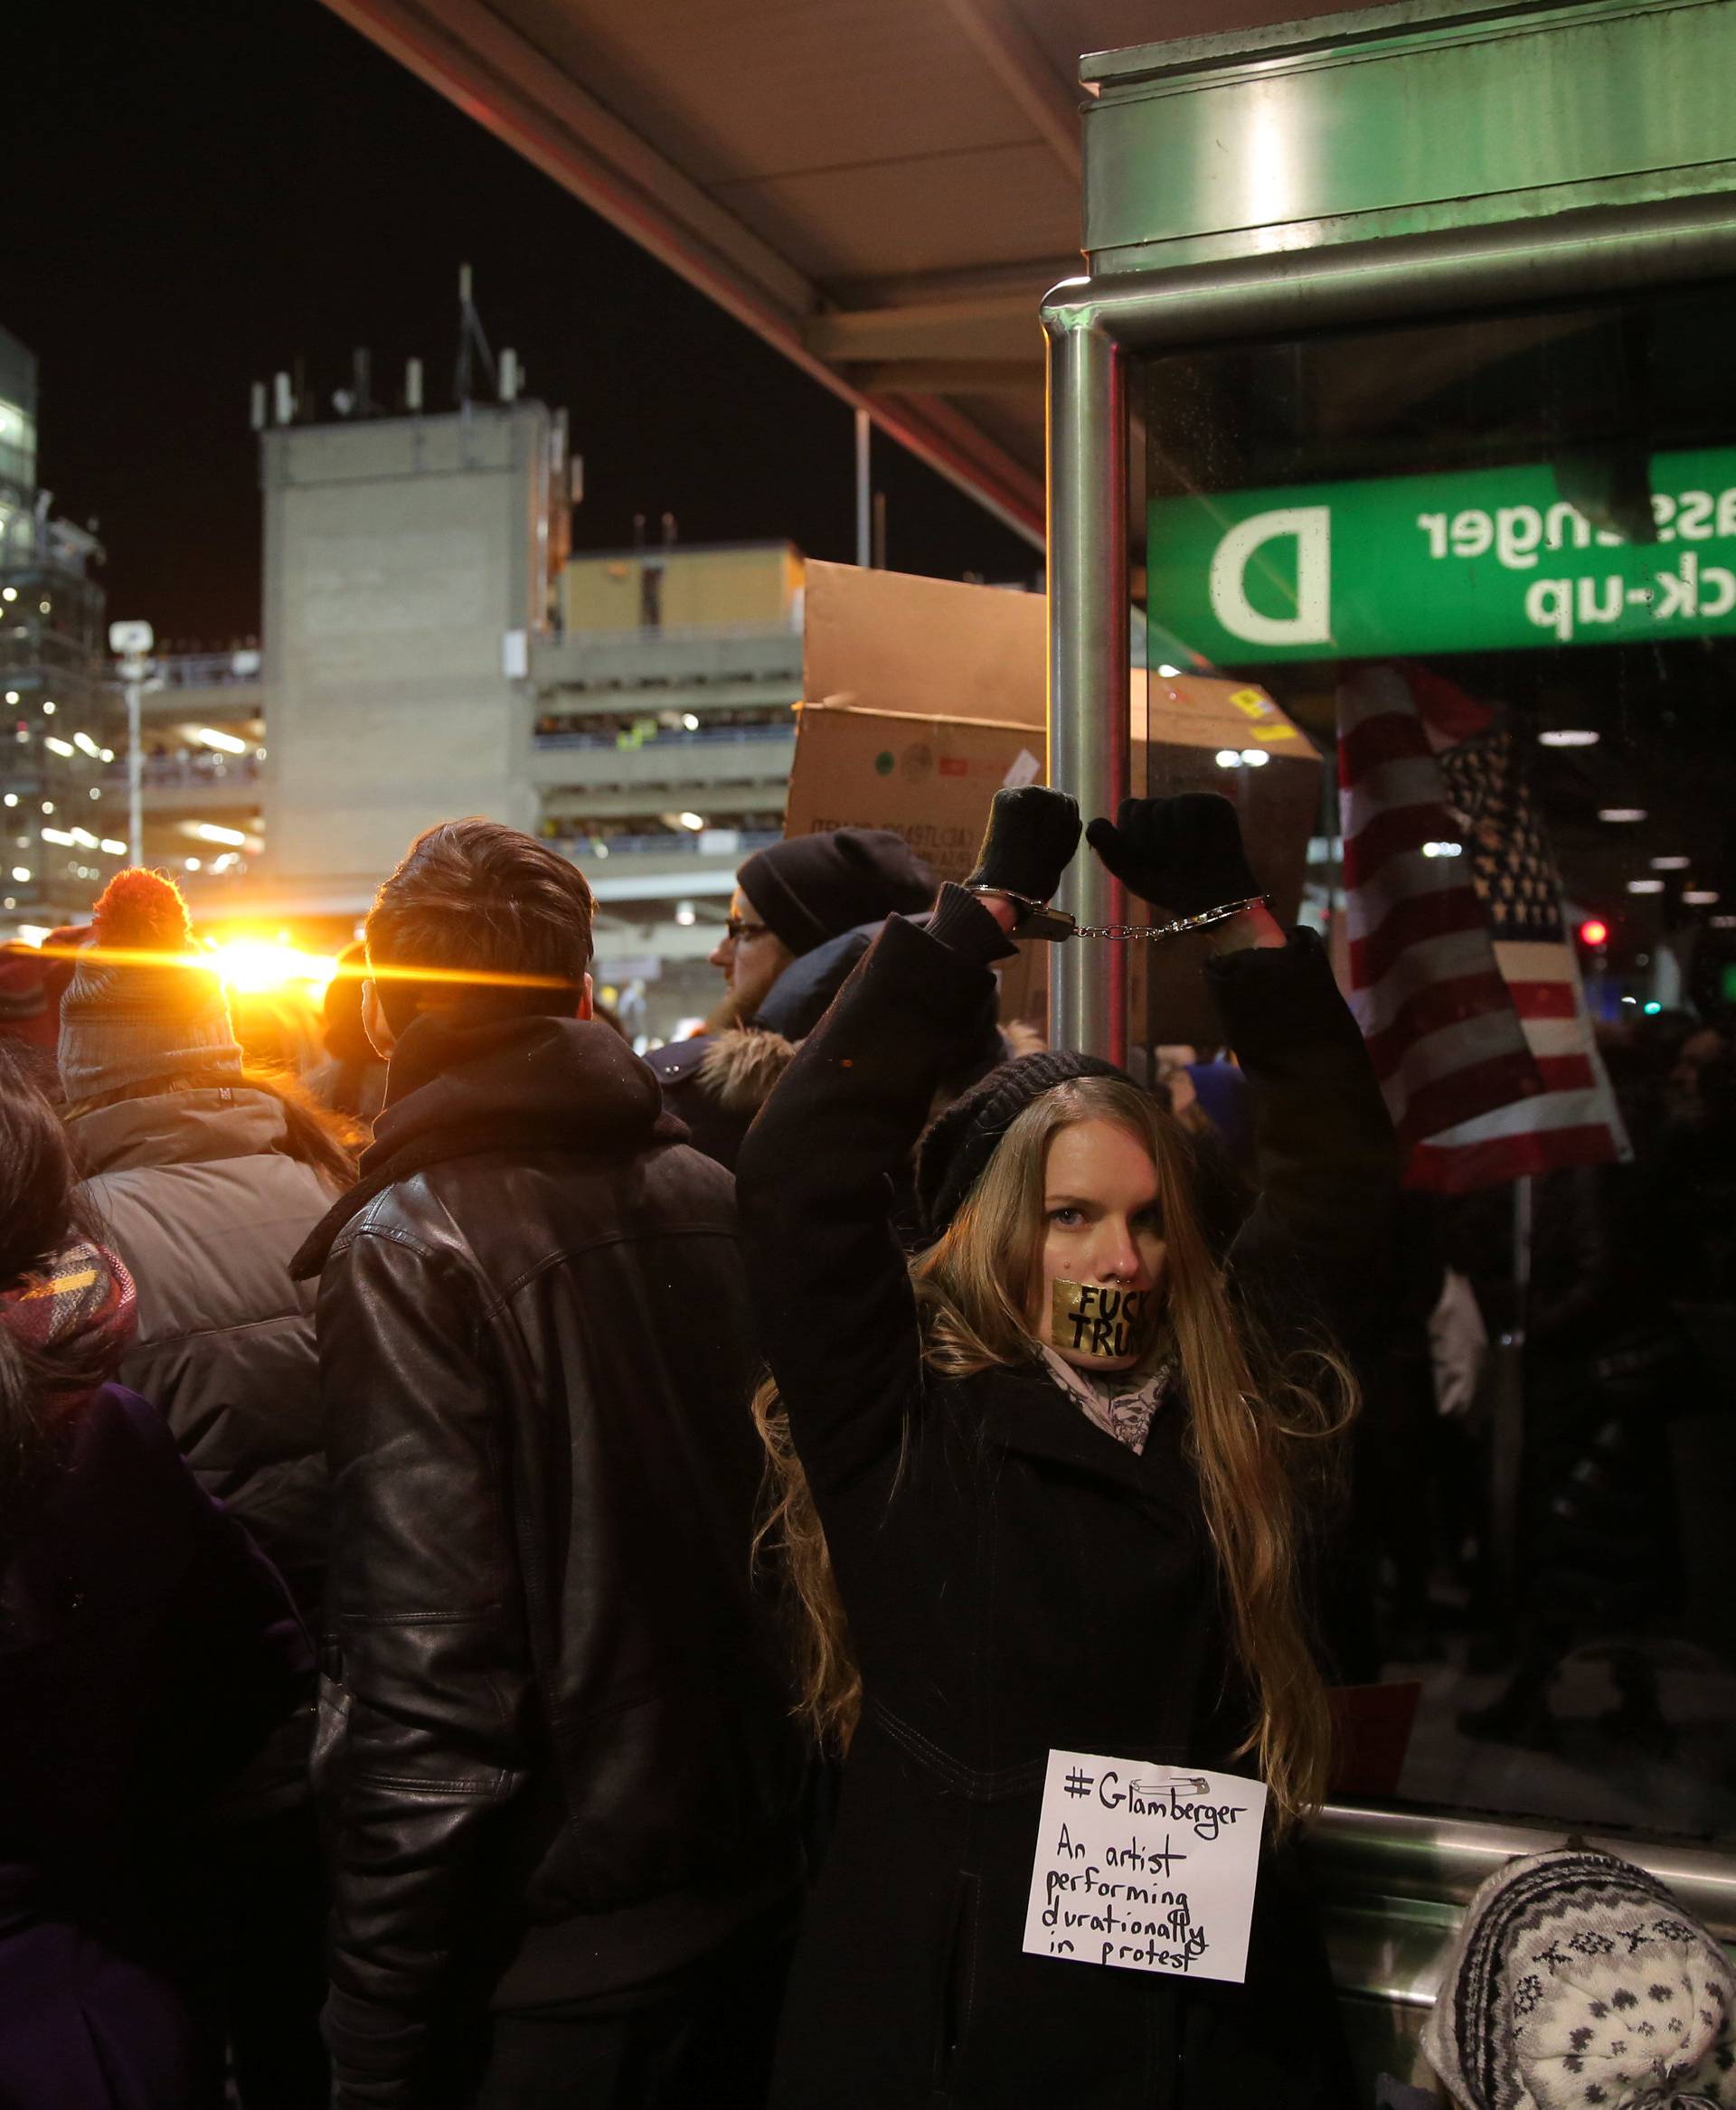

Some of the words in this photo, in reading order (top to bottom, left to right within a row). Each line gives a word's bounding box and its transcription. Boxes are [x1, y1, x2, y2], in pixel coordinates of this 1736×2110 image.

[1063, 1766, 1248, 1841] #Glamberger
[1056, 1822, 1086, 1860] An
[1105, 1833, 1187, 1879] artist
[1042, 1894, 1210, 1955] durationally
[1046, 1866, 1191, 1926] performing
[1050, 1930, 1075, 1954] in
[1101, 1938, 1199, 1972] protest
